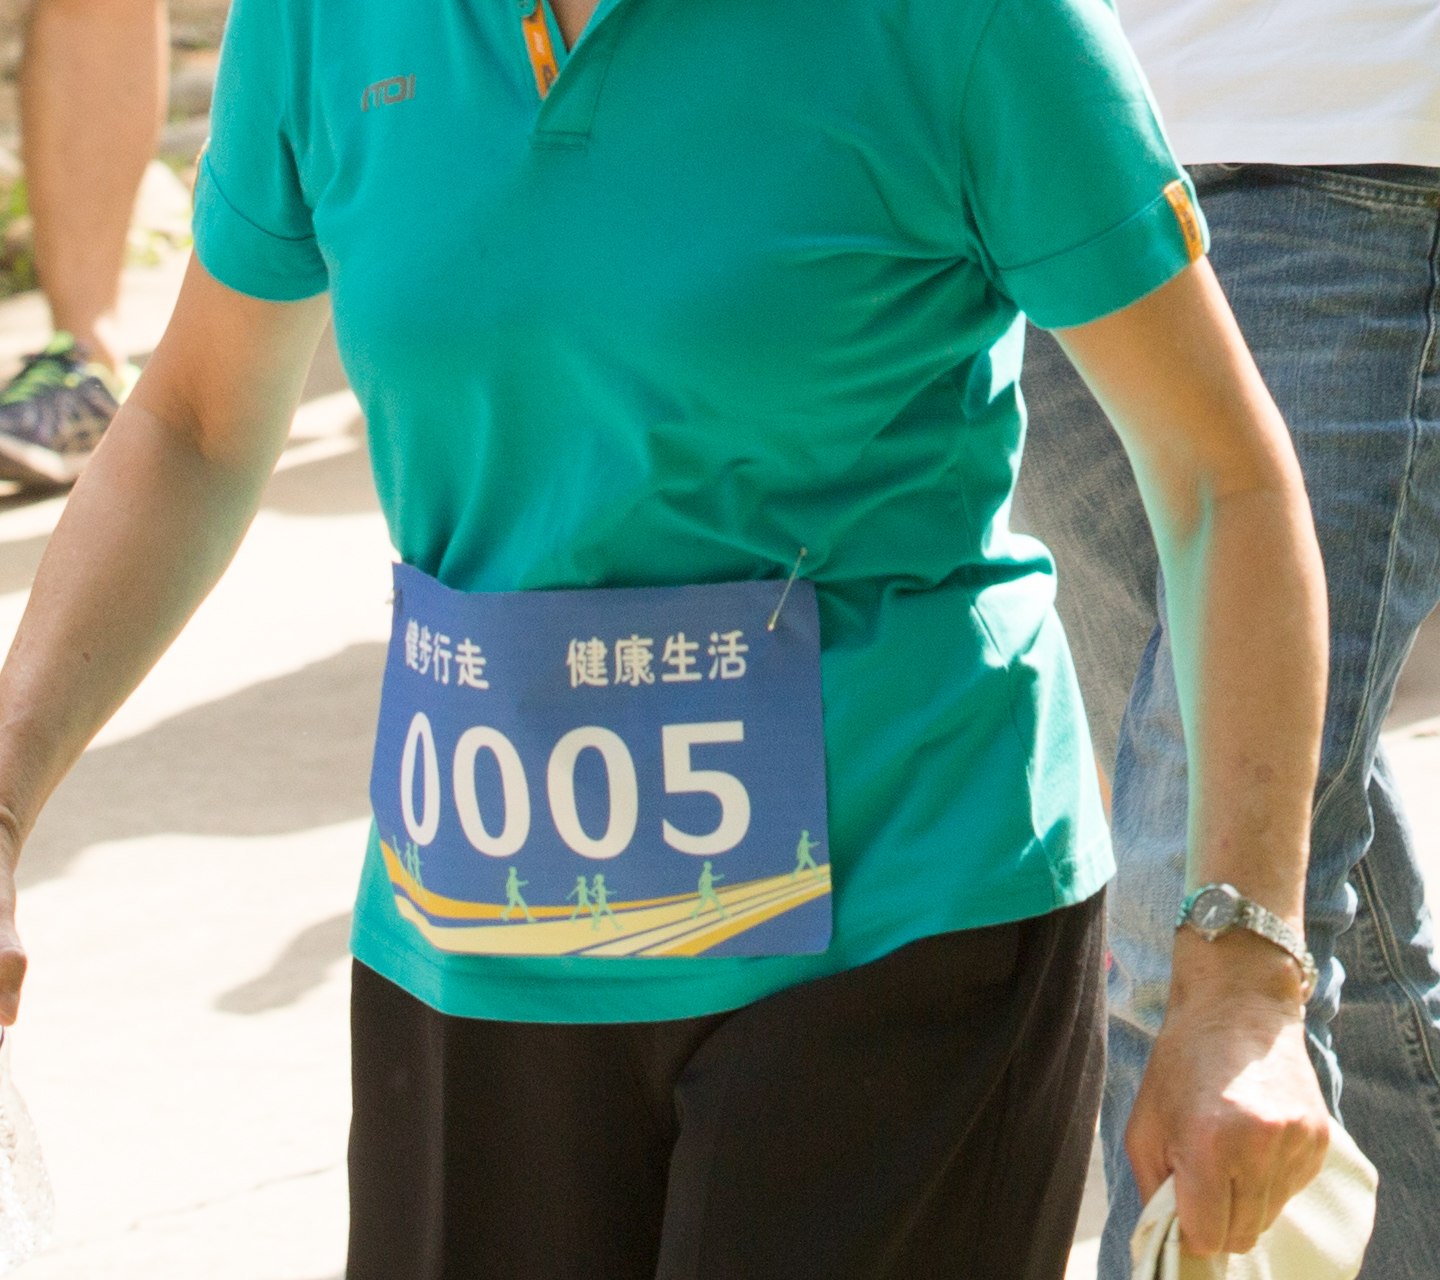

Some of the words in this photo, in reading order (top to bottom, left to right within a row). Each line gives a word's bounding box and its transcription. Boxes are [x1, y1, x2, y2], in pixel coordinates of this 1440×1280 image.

[404, 619, 490, 690] 健步行走
[566, 629, 750, 689] 健康生活
[400, 710, 752, 860] 0005
